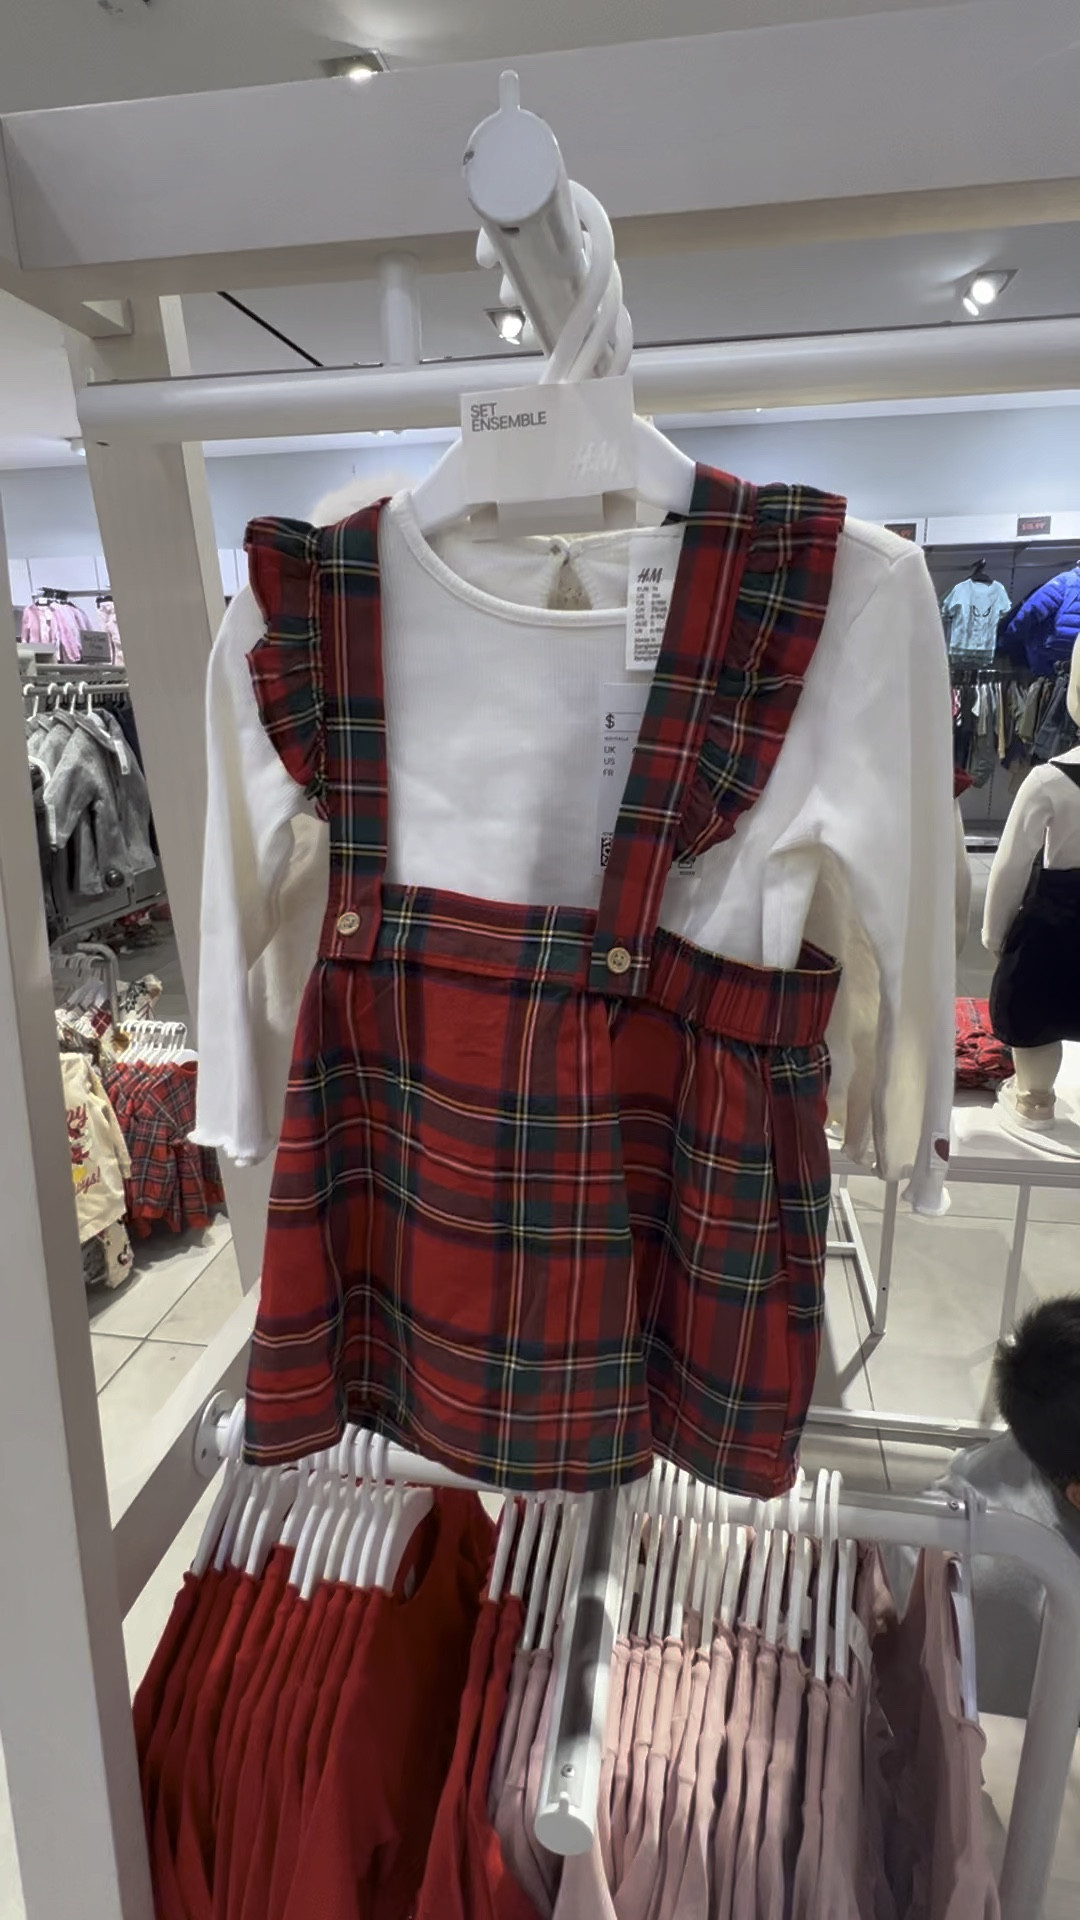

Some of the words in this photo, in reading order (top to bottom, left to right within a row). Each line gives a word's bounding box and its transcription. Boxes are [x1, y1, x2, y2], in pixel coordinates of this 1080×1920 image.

[470, 403, 497, 418] SET
[471, 411, 547, 432] ENSEMBLE
[637, 567, 663, 583] H&M
[604, 713, 615, 729] $
[604, 746, 616, 754] UK
[604, 757, 615, 765] US
